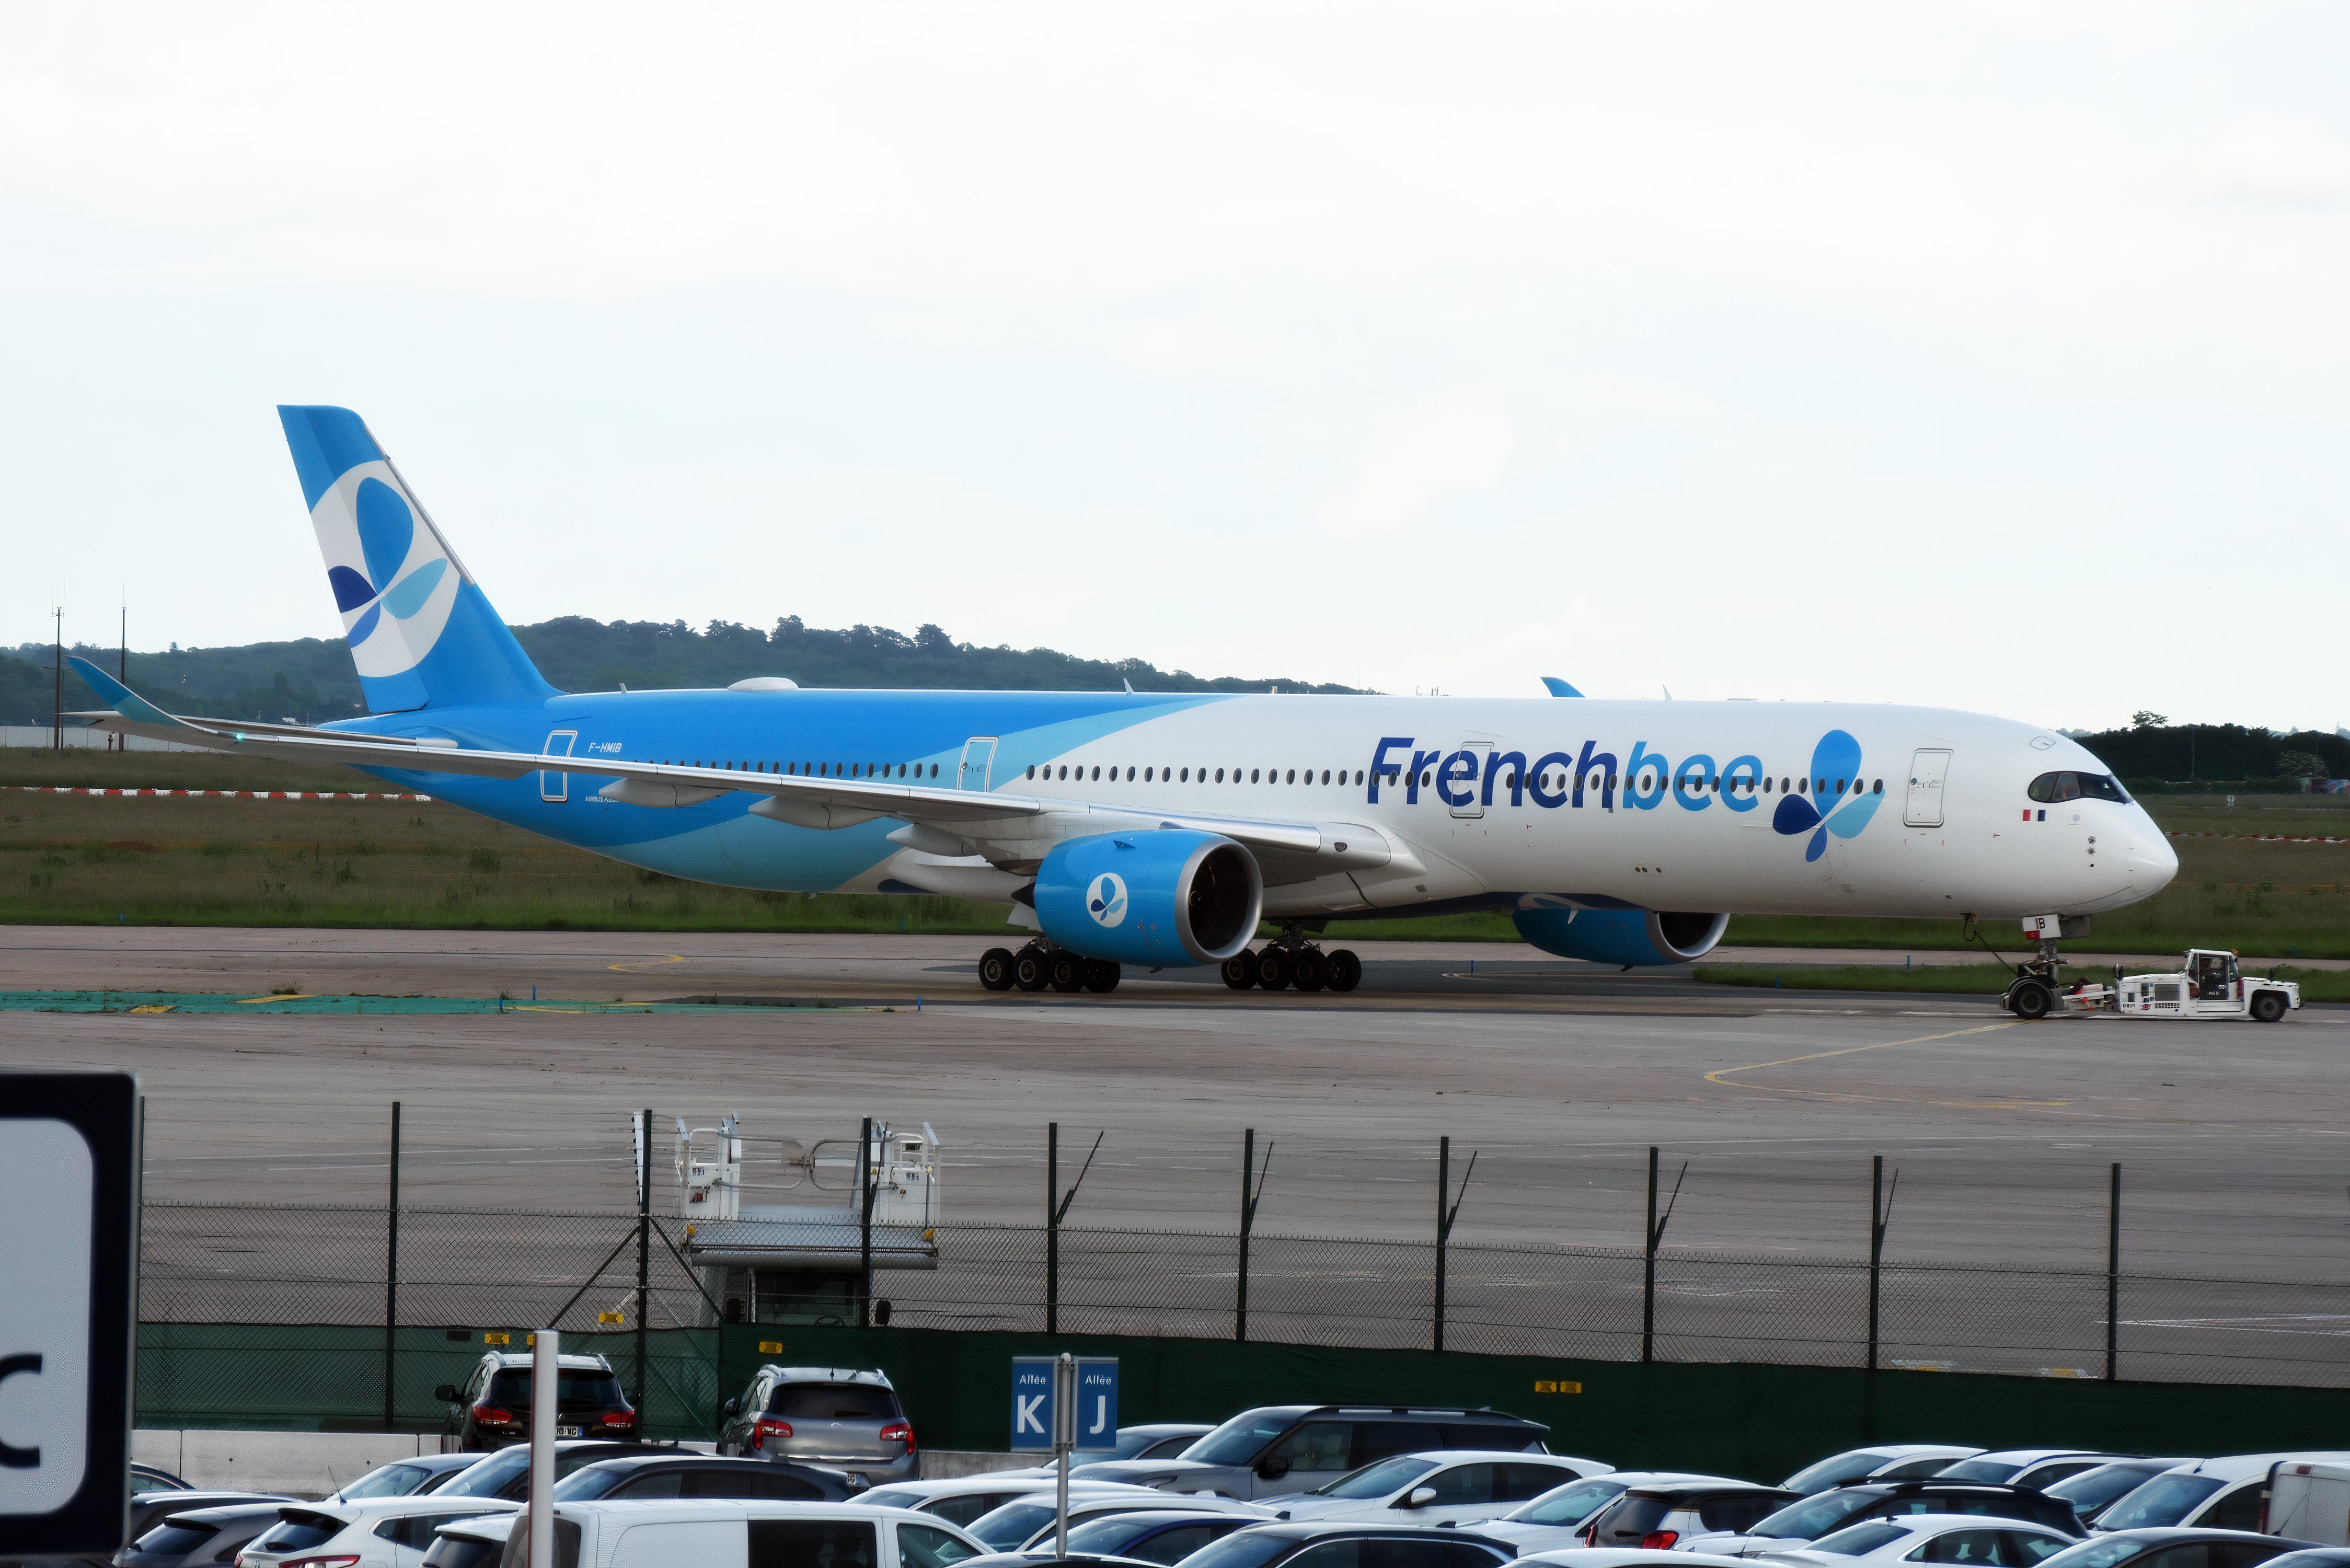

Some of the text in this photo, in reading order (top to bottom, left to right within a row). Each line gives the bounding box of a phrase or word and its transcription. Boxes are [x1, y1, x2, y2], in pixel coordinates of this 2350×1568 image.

[588, 742, 622, 753] F-HMIB
[1019, 1374, 1046, 1385] Allée
[1085, 1374, 1112, 1385] Allée
[1017, 1394, 1046, 1433] K
[1089, 1395, 1105, 1435] J
